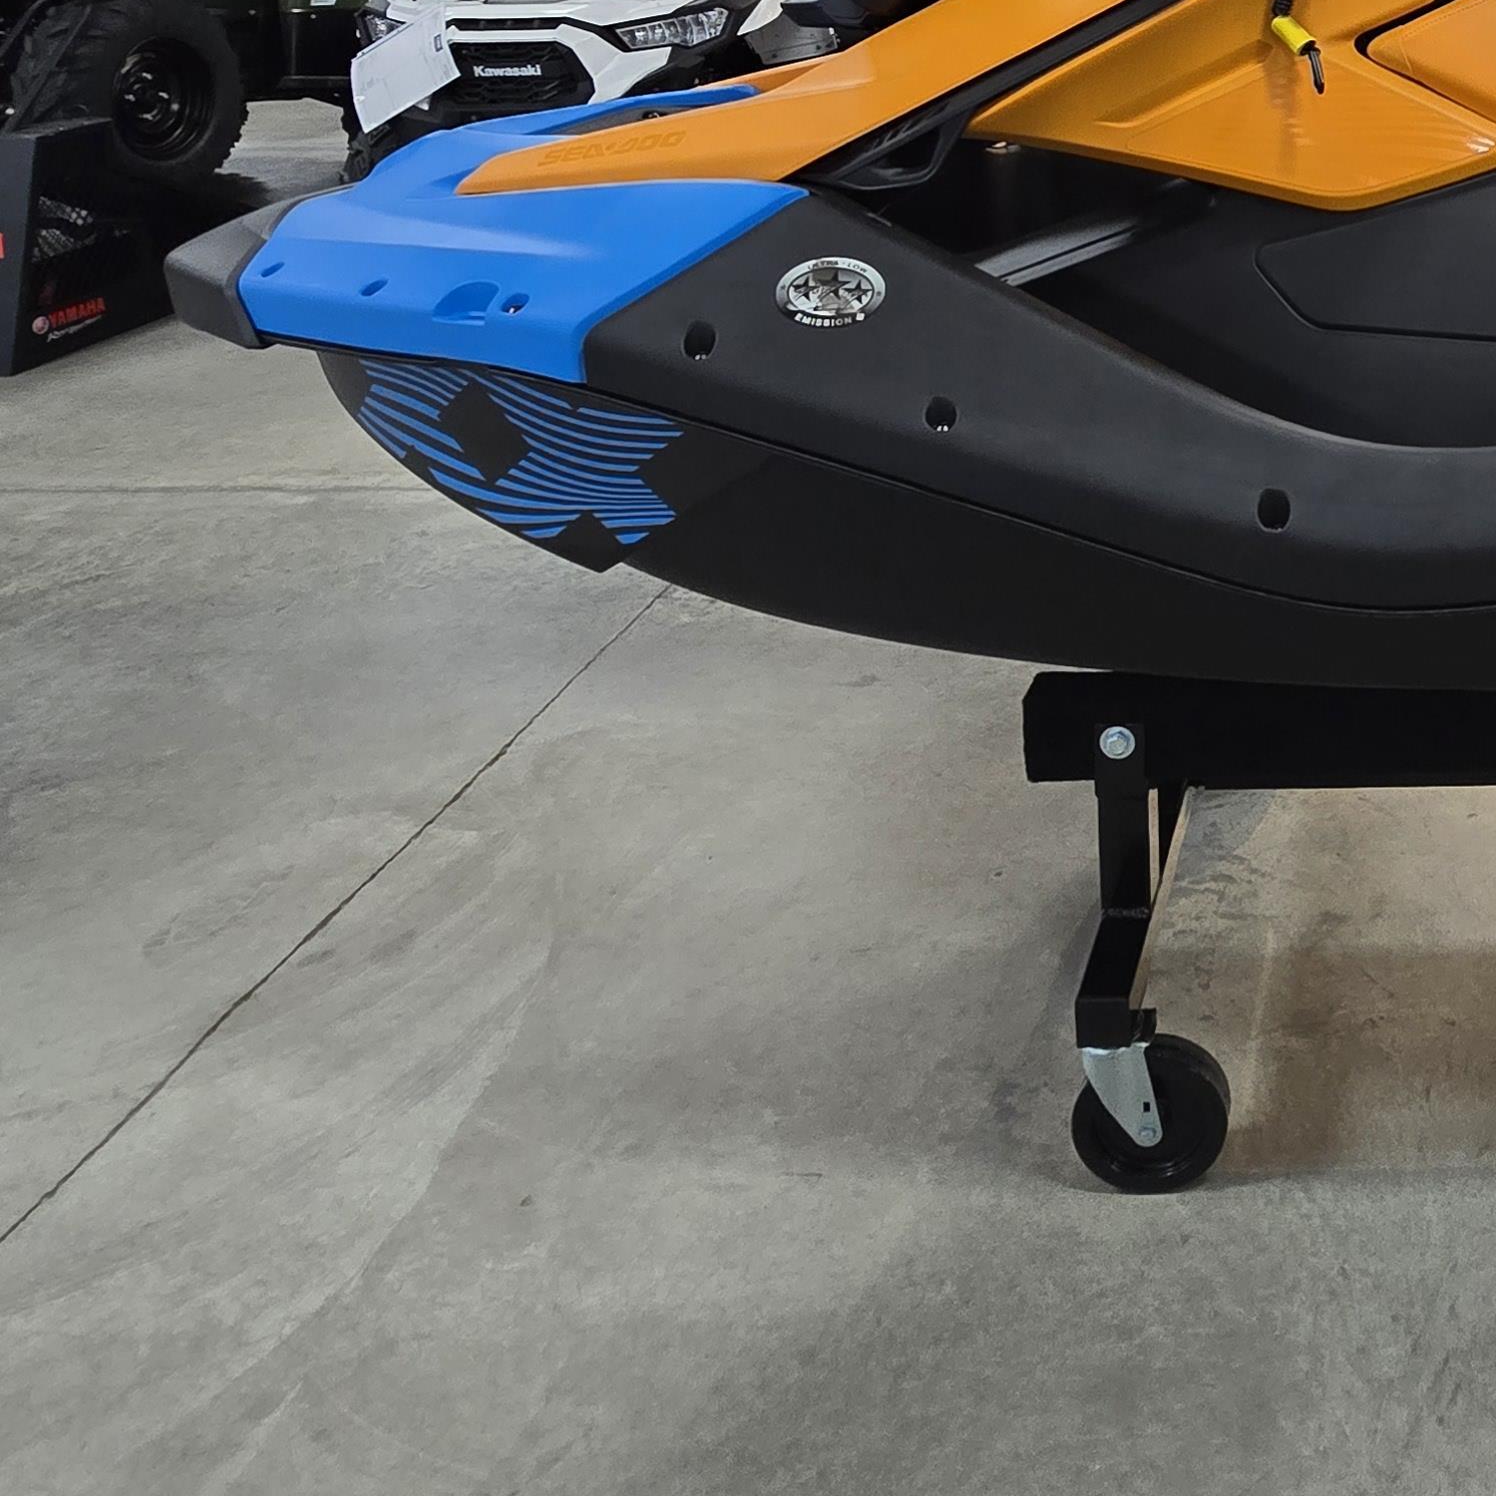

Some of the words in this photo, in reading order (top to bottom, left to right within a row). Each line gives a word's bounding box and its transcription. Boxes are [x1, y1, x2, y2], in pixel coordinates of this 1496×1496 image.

[473, 64, 542, 78] Kawasaki
[47, 296, 107, 329] YAMAHA
[794, 312, 853, 328] EMISSION
